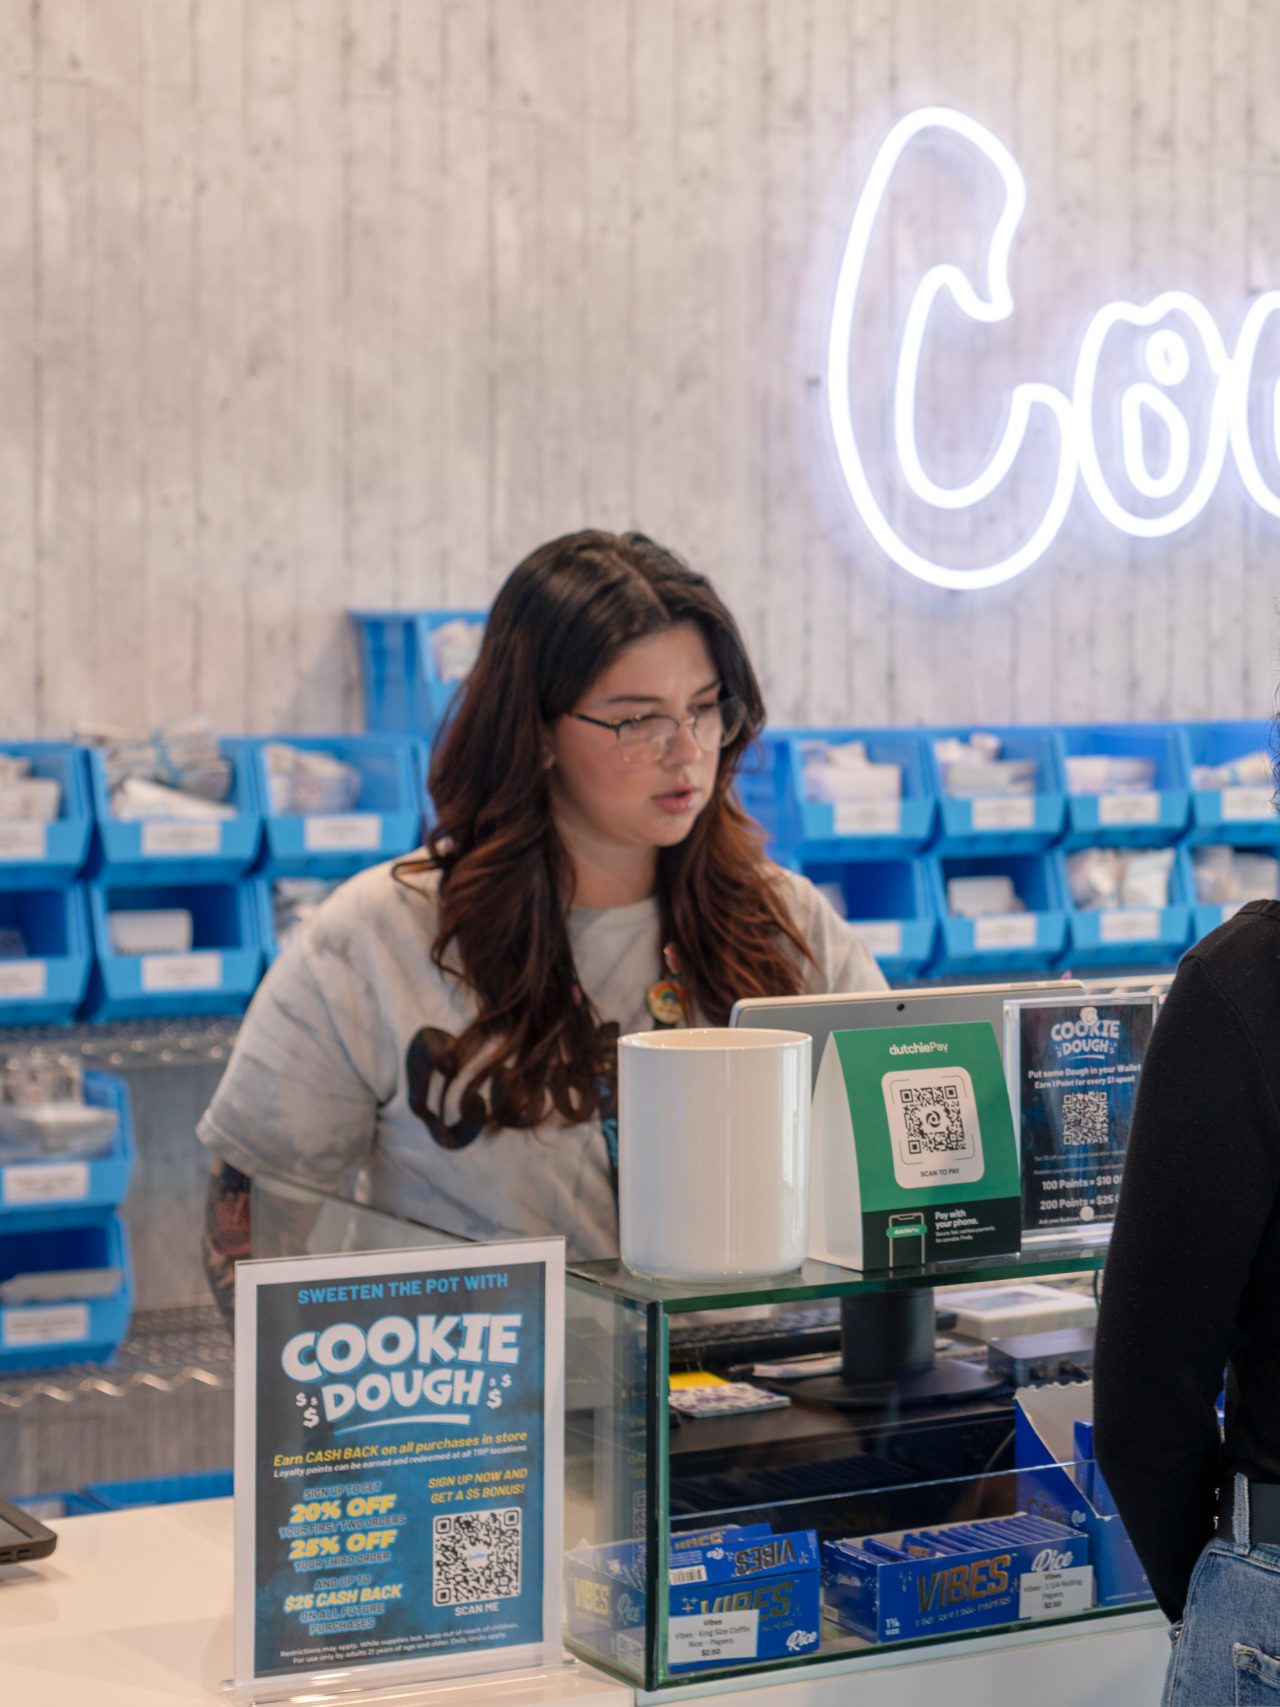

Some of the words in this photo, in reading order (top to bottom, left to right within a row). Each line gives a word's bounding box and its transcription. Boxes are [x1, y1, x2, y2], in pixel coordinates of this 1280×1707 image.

[1051, 1020, 1120, 1041] COOKIE
[889, 1042, 948, 1055] dutchiePay
[1062, 1038, 1109, 1055] DOUGH
[1028, 1070, 1042, 1079] Put
[1065, 1067, 1089, 1077] Dough
[1090, 1066, 1097, 1074] in
[1098, 1066, 1116, 1075] your
[1117, 1063, 1141, 1072] Wallet
[1034, 1081, 1051, 1089] Earn
[1056, 1079, 1074, 1087] Point
[1075, 1078, 1085, 1086] for
[1087, 1078, 1106, 1086] every
[1116, 1075, 1136, 1083] spent
[920, 1170, 938, 1178] SCAN
[1042, 1181, 1058, 1191] 100
[1059, 1178, 1089, 1189] Points
[1096, 1176, 1112, 1186] $10
[1040, 1200, 1058, 1210] 200
[1059, 1198, 1088, 1208] Points
[1096, 1195, 1114, 1205] $25
[935, 1211, 949, 1220] Pay
[949, 1209, 967, 1218] with
[935, 1221, 952, 1230] your
[953, 1218, 979, 1229] phone.
[298, 1284, 383, 1304] SWEETEN
[388, 1281, 421, 1297] THE
[426, 1277, 459, 1294] POT
[464, 1273, 508, 1291] WITH
[281, 1313, 522, 1383] COOKIE
[321, 1369, 485, 1422] DOUGH
[273, 1454, 303, 1466] Earn
[305, 1449, 342, 1463] CASH
[343, 1445, 379, 1459] BACK
[381, 1446, 397, 1455] on
[399, 1441, 415, 1454] all
[415, 1437, 480, 1454] purchases
[482, 1433, 493, 1444] in
[495, 1432, 527, 1443] store
[273, 1467, 305, 1478] Loyalty
[306, 1465, 332, 1476] points
[334, 1463, 349, 1471] can
[350, 1460, 361, 1469] be
[361, 1458, 392, 1468] earned
[393, 1457, 408, 1465] and
[409, 1452, 450, 1463] redeemed
[451, 1451, 460, 1459] at
[461, 1450, 472, 1458] all
[490, 1445, 527, 1455] locations
[428, 1476, 455, 1489] SIGN
[457, 1474, 472, 1485] UP
[474, 1471, 502, 1483] NOW
[503, 1468, 528, 1480] AND
[304, 1487, 329, 1499] SIGN
[330, 1485, 343, 1496] UP
[346, 1483, 360, 1494] TO
[361, 1481, 382, 1493] GET
[430, 1491, 454, 1504] GET
[455, 1490, 464, 1501] A
[465, 1488, 481, 1501] $5
[482, 1483, 525, 1498] BONUS!
[289, 1500, 341, 1523] 20%
[346, 1494, 397, 1516] OFF
[279, 1526, 307, 1539] YOUR
[309, 1522, 339, 1536] FIRST
[340, 1519, 363, 1531] TWO
[365, 1514, 406, 1528] ORDERS
[288, 1535, 341, 1560] 25%
[346, 1529, 398, 1552] OFF
[294, 1559, 323, 1572] YOUR
[324, 1556, 354, 1569] THIRD
[356, 1552, 391, 1566] ORDER
[735, 1538, 795, 1576] VIBES
[1031, 1548, 1073, 1573] Rice
[314, 1577, 338, 1590] AND
[339, 1575, 355, 1588] UP
[356, 1574, 371, 1586] TO
[918, 1554, 1011, 1613] VIBES
[284, 1595, 315, 1614] $25
[316, 1589, 359, 1608] CASH
[360, 1584, 403, 1602] BACK
[574, 1577, 610, 1616] VIBES
[300, 1611, 317, 1623] ON
[319, 1609, 340, 1620] ALL
[341, 1603, 385, 1617] FUTURE
[454, 1605, 485, 1617] SCAN
[485, 1602, 500, 1613] ME
[309, 1618, 376, 1636] PURCHASES
[675, 1632, 693, 1640] Vibes
[714, 1628, 728, 1636] Size
[688, 1640, 703, 1648] Rice
[710, 1637, 734, 1646] Papers
[786, 1630, 817, 1651] Rice
